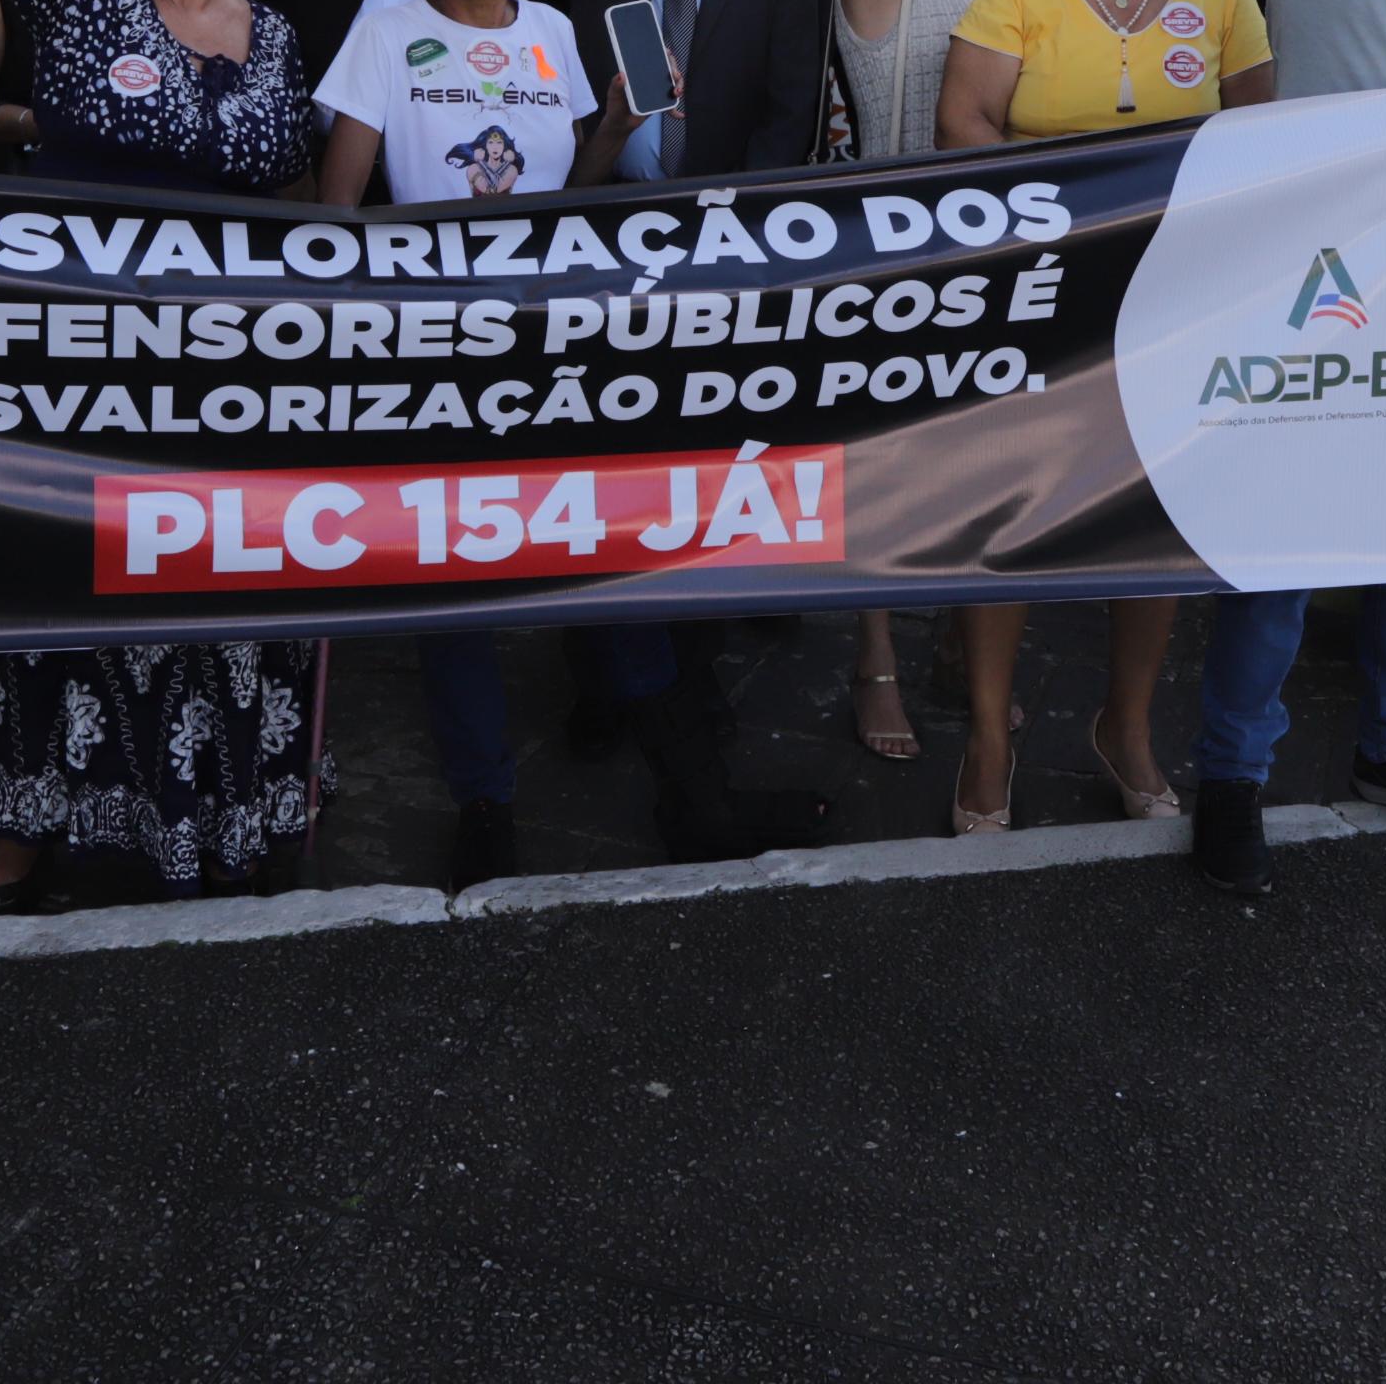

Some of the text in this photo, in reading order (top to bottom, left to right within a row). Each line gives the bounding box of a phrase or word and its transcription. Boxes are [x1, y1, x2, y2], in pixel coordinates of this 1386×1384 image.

[862, 182, 1072, 254] DOS
[544, 275, 991, 354] PÚBLICOS
[1007, 253, 1065, 322] É
[680, 366, 797, 417] DO
[816, 347, 1047, 408] POVO.
[1197, 417, 1249, 428] Associação
[1250, 417, 1267, 426] das
[1268, 414, 1317, 425] Defensoras
[1325, 411, 1374, 421] Defensores
[126, 438, 825, 576] PLC 154 JÁ!
